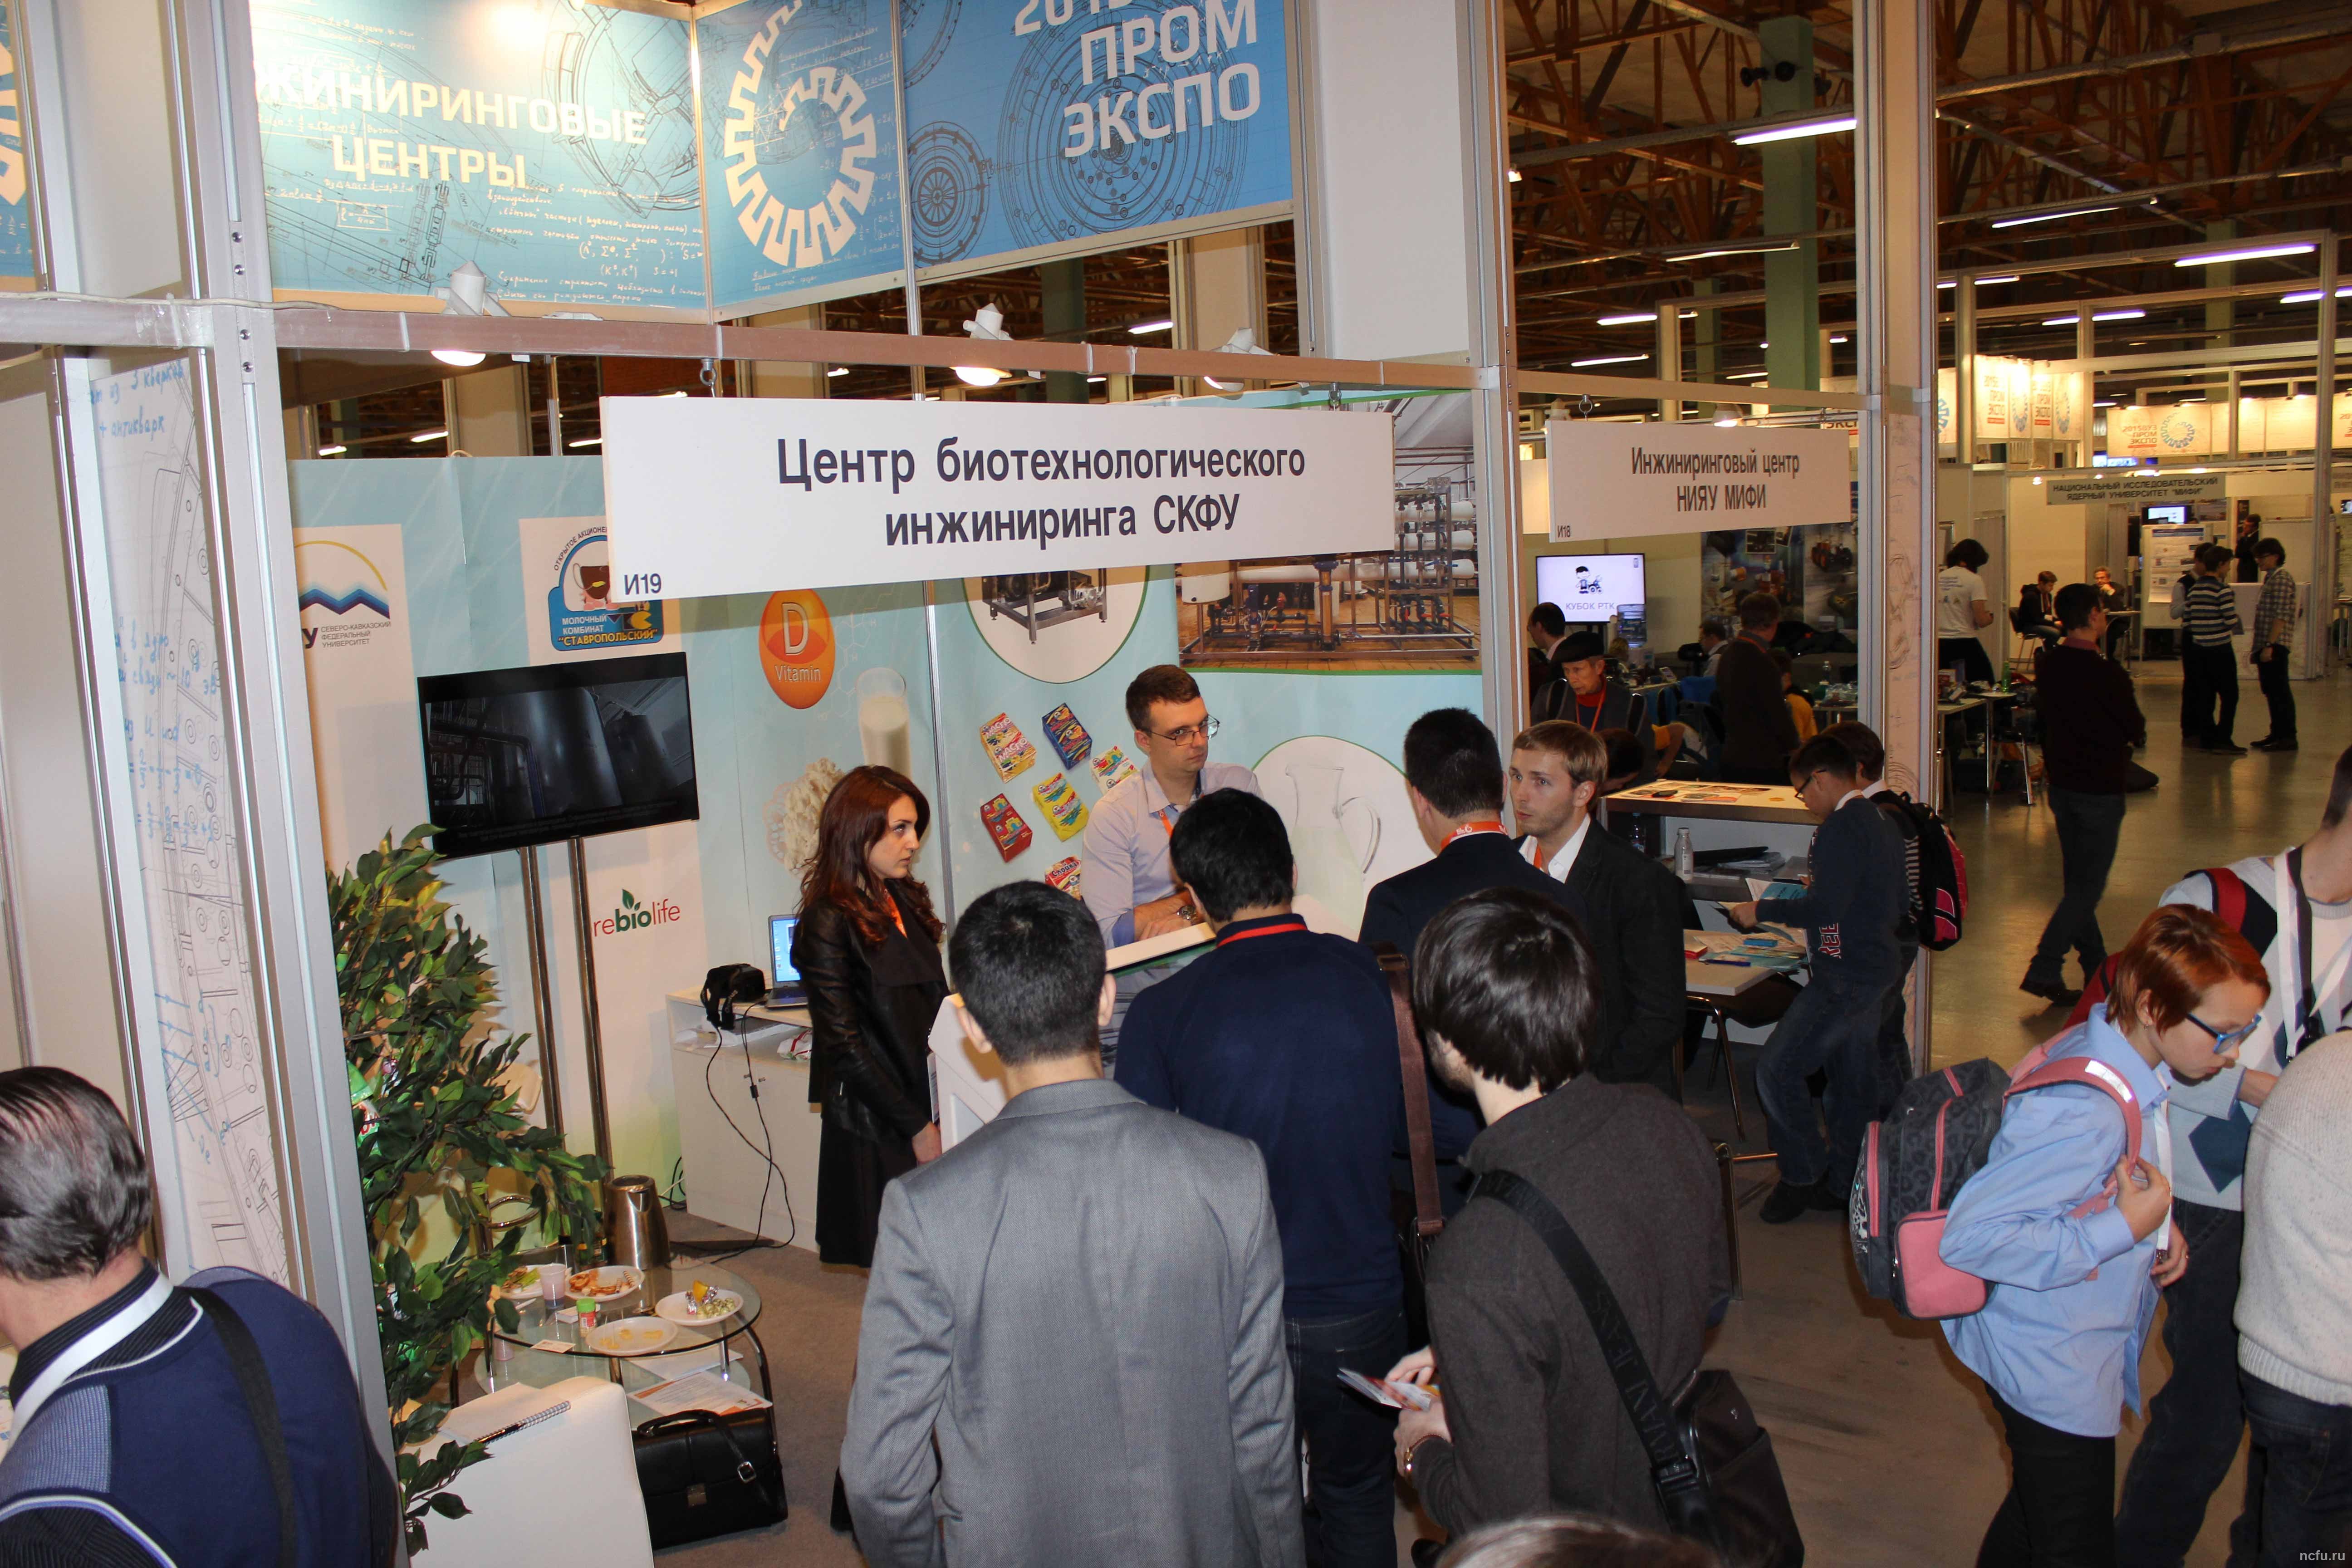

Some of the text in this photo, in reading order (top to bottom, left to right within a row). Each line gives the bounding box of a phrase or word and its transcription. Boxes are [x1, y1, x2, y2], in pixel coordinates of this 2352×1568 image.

[1081, 0, 1257, 85] ПРОМ
[1064, 63, 1260, 157] ЭКСПО
[333, 134, 525, 188] ЦЕНТРЫ
[777, 436, 1305, 494] Центр биотехнологического
[1631, 447, 1799, 480] Инжиниринговый центр
[2053, 477, 2218, 492] НАЦИОНАЛЬНЫЙ ИССЛЕДОВАТЕЛЬСКИЙ
[2067, 491, 2106, 500] ЯДЕРНЫЙ
[2109, 489, 2167, 499] УНИВЕРСИТЕТ
[1677, 484, 1766, 512] НИЯУ МИФИ
[885, 493, 1240, 550] инжиниринга СКФУ
[1557, 525, 1571, 538] И18
[554, 526, 608, 571] ОТКРЫТОЕ АКЦИОНЕ
[624, 573, 662, 596] И19
[321, 621, 391, 632] СЕВЕРО-КАВКАЗСКИЙ
[562, 614, 607, 625] МОЛОЧНЫЙ
[563, 624, 604, 635] КОМБИНАТ
[782, 602, 809, 656] D
[321, 631, 371, 640] ФЕДЕРАЛЬНЫЙ
[323, 638, 370, 648] УНИВЕРСИТЕТ
[774, 665, 821, 682] Vitamin
[998, 737, 1028, 762] МАСЛО
[593, 898, 680, 937] rebiolife
